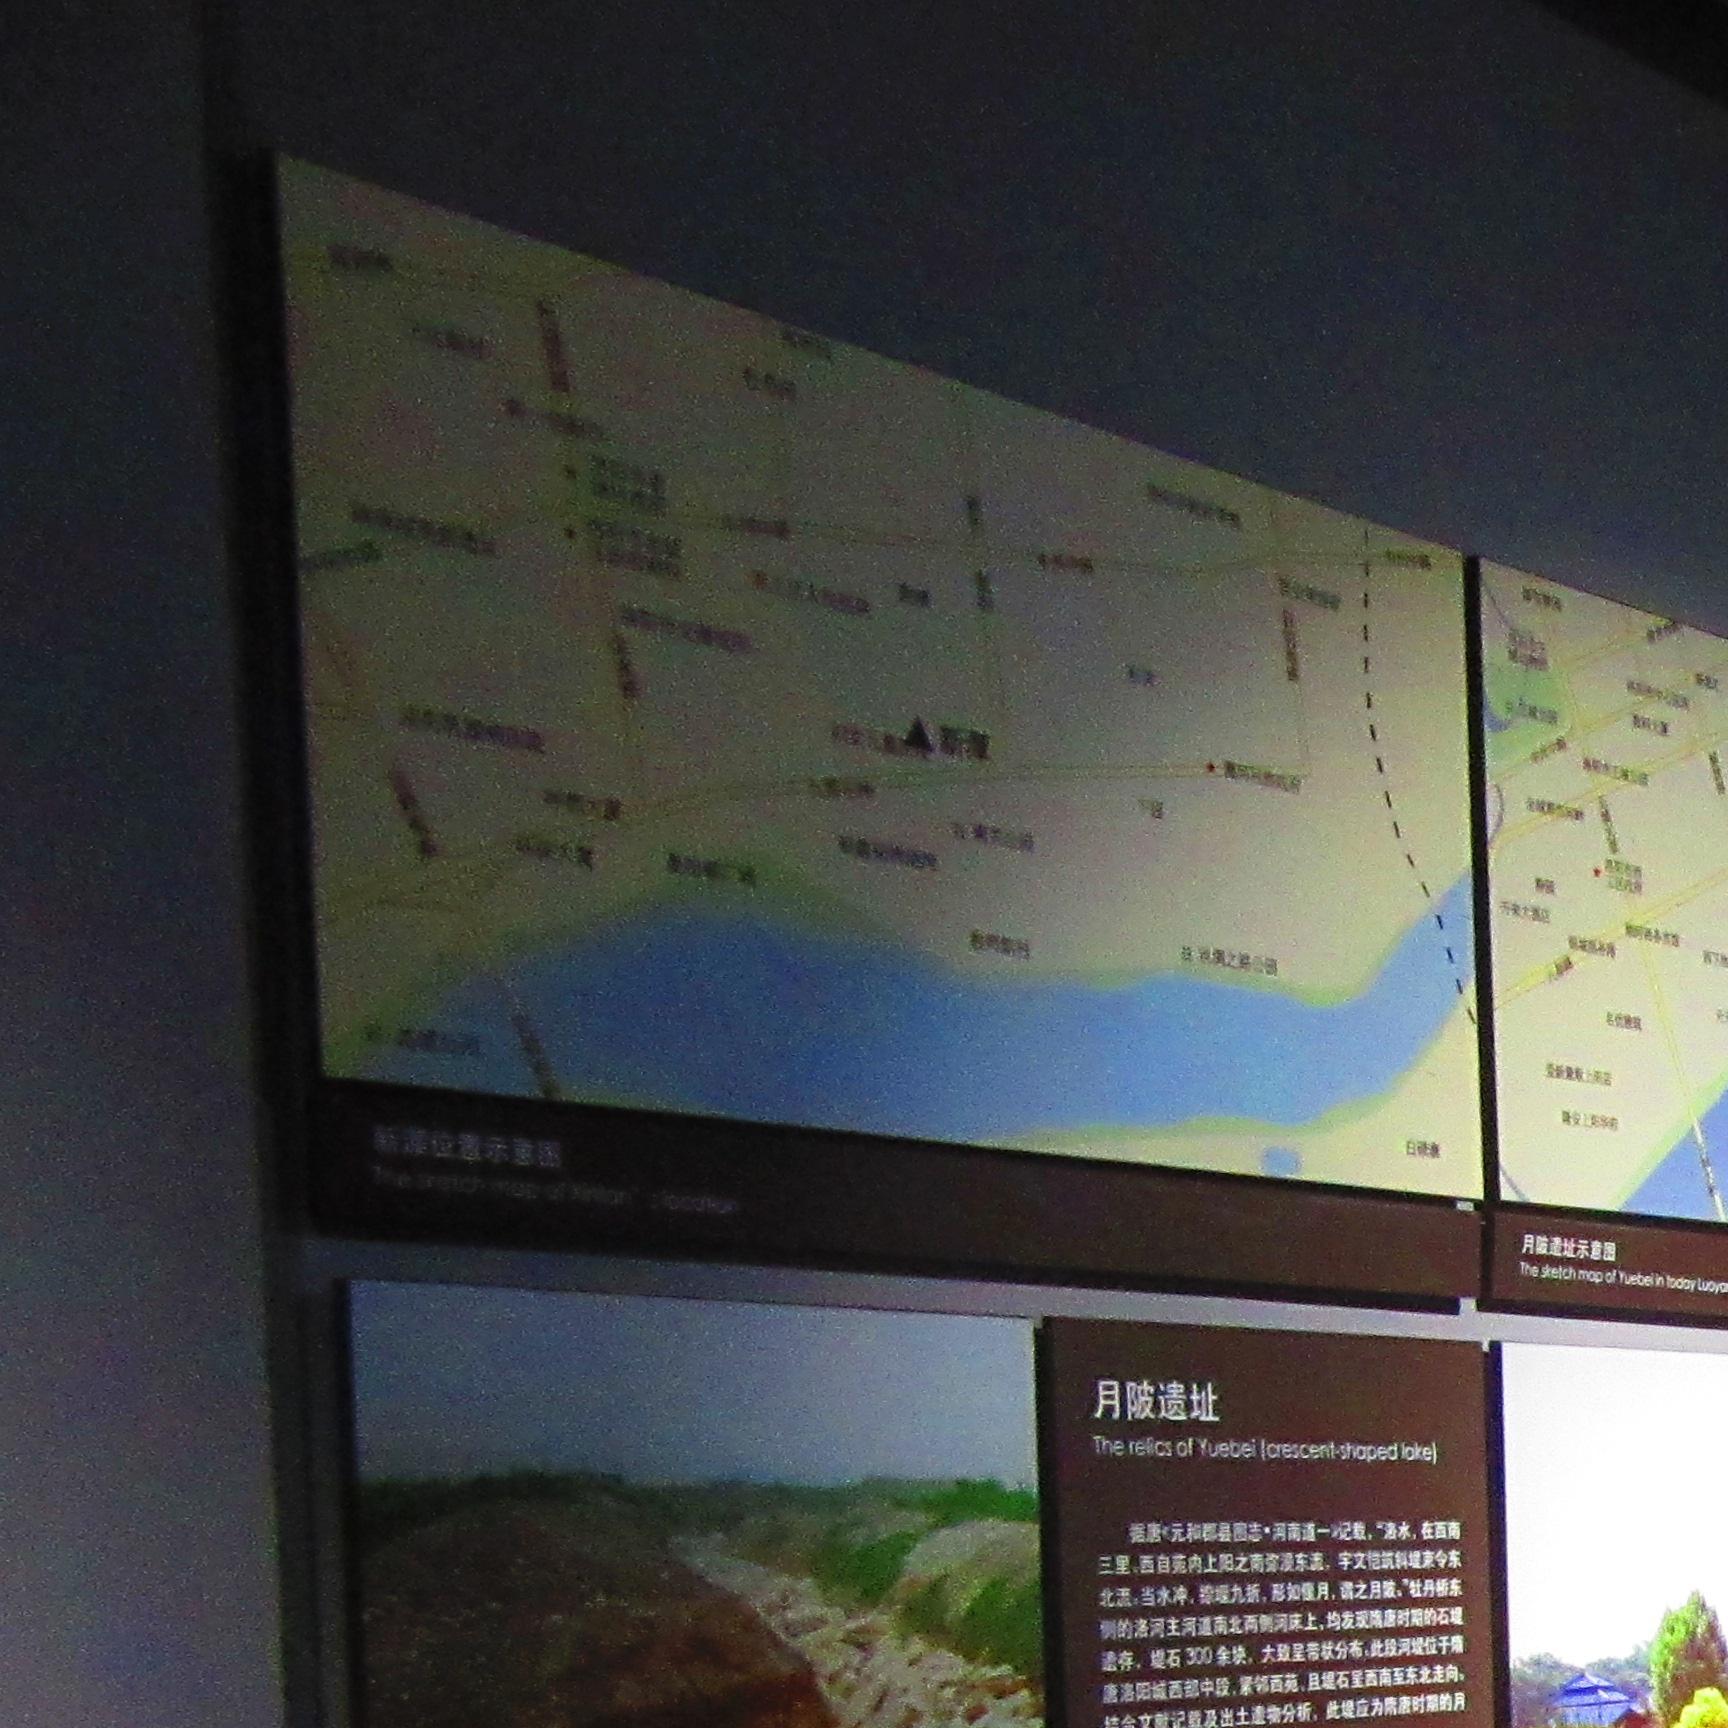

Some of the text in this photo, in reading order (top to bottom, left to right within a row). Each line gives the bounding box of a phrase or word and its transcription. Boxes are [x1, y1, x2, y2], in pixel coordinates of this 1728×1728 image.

[1521, 1234, 1616, 1261] 月陂遗址示意图
[1519, 1260, 1539, 1277] The
[1540, 1263, 1577, 1280] sketch
[1576, 1269, 1604, 1283] map
[1604, 1268, 1617, 1284] of
[1653, 1272, 1665, 1286] in
[1664, 1274, 1696, 1292] today
[1093, 1380, 1219, 1421] 月陂遗址
[1092, 1434, 1124, 1456] The
[1128, 1436, 1172, 1457] relics
[1175, 1436, 1193, 1457] of
[1398, 1441, 1437, 1464] lake)
